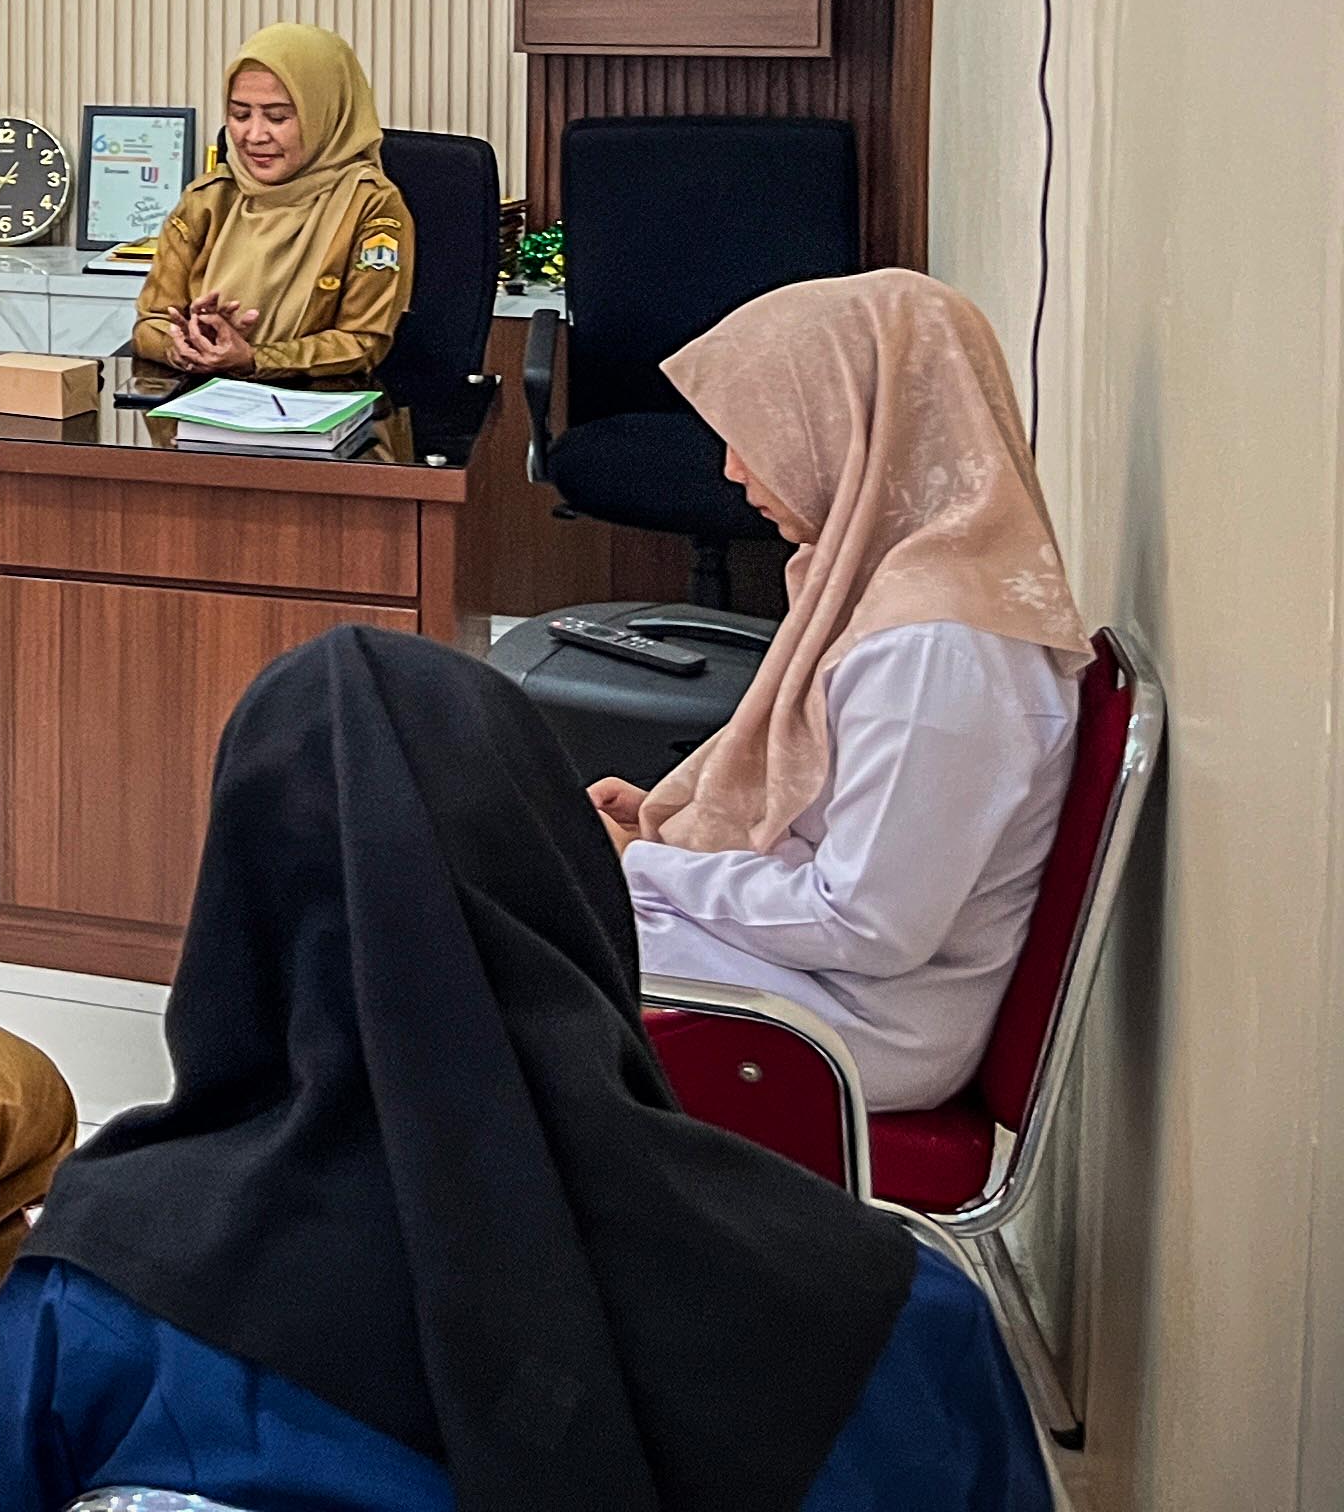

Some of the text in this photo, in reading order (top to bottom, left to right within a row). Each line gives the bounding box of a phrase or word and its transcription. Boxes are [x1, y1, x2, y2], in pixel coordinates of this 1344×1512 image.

[40, 149, 54, 165] 2
[47, 172, 60, 187] 3
[40, 194, 53, 210] 4
[22, 210, 35, 226] 5
